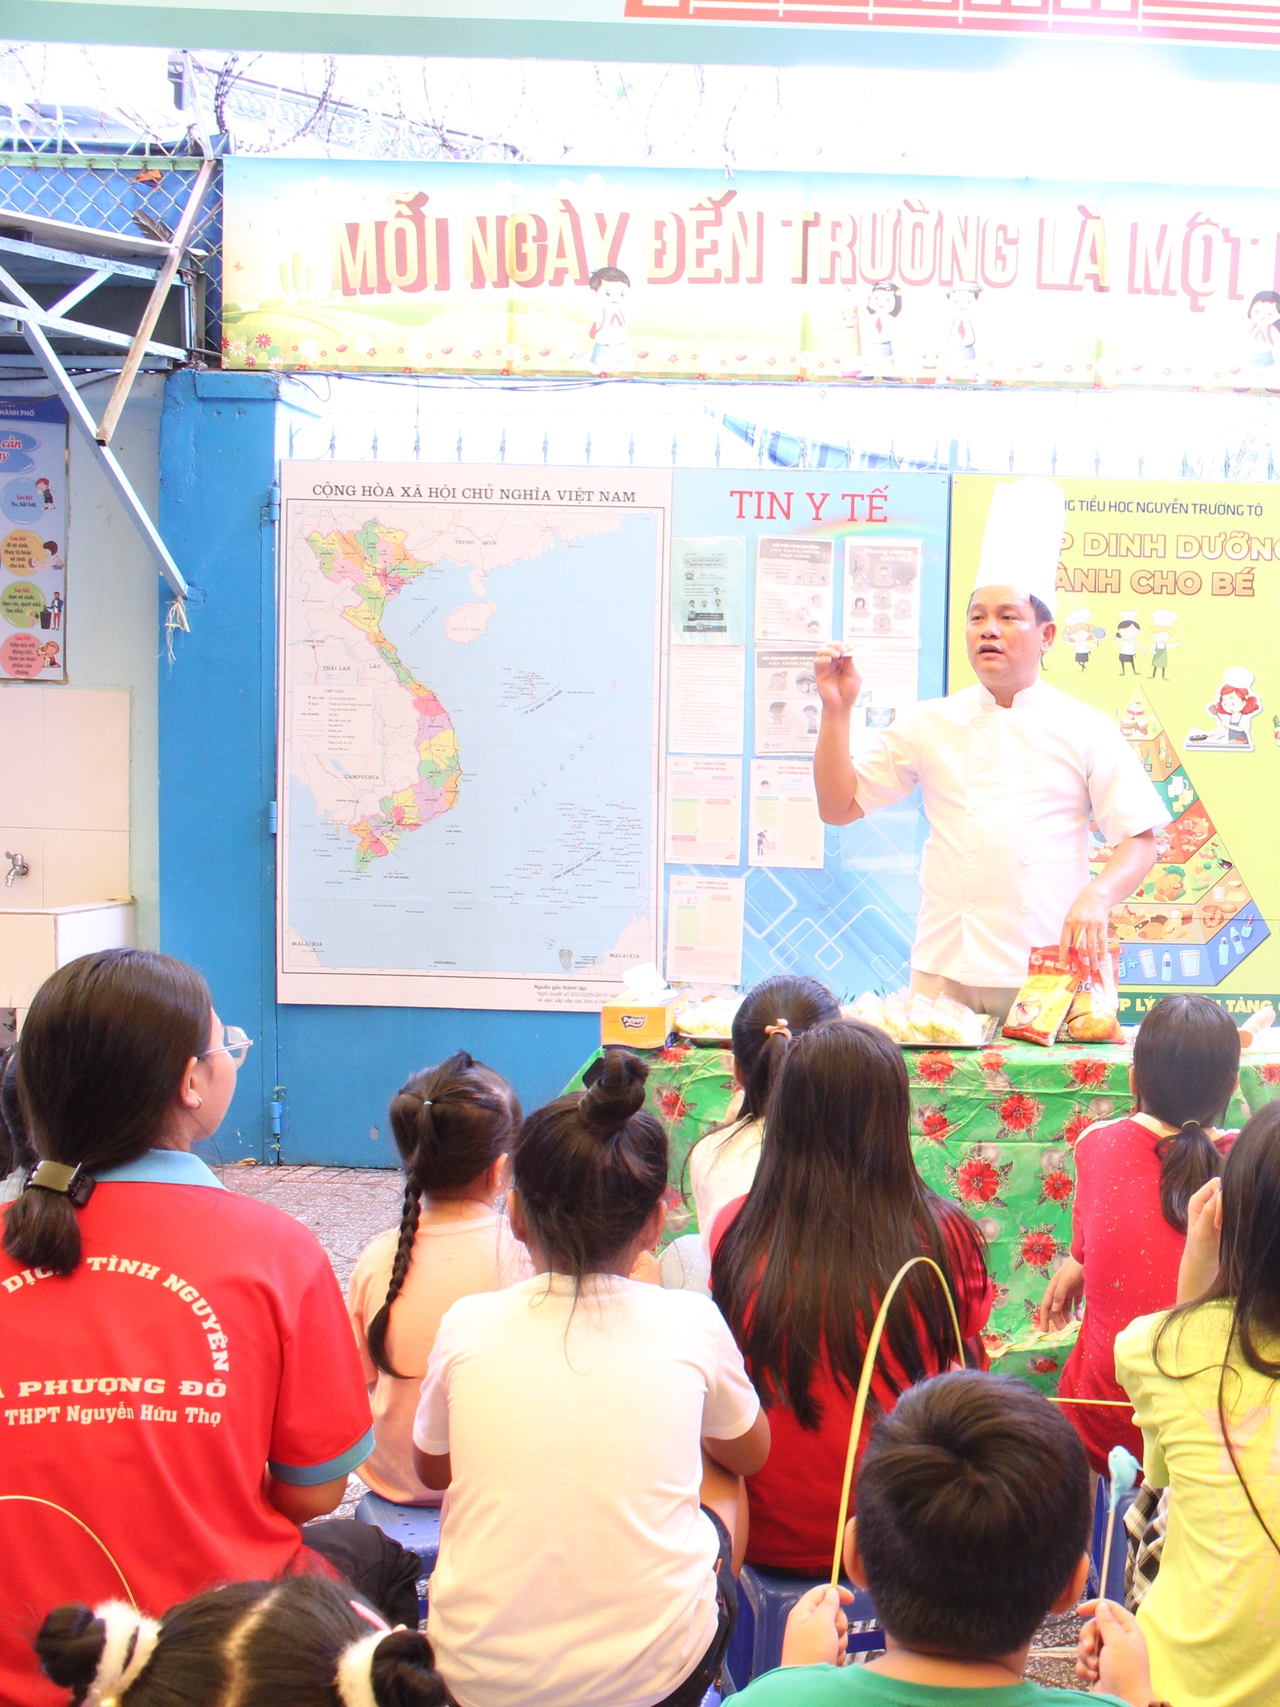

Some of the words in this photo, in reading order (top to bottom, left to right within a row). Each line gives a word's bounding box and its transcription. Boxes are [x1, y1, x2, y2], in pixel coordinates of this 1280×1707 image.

[329, 191, 451, 296] MỖI
[461, 198, 631, 289] NGÀY
[640, 189, 764, 284] ĐẾN
[781, 198, 1020, 289] TRƯỜNG
[1036, 204, 1110, 292] LÀ
[1128, 211, 1260, 312] MỘT
[2, 435, 21, 449] cần
[312, 482, 357, 499] CỘNG
[360, 483, 394, 498] HÒA
[400, 484, 422, 498] XÃ
[427, 484, 457, 500] HỘI
[461, 482, 494, 500] CHỦ
[499, 484, 551, 501] NGHĨA
[556, 485, 595, 504] VIỆT
[598, 490, 637, 503] NAM
[730, 490, 794, 520] TIN
[805, 492, 830, 521] Y
[841, 484, 891, 523] TẾ
[1078, 495, 1106, 512] TIỂU
[1109, 500, 1134, 515] HỌC
[1136, 497, 1189, 515] NGUYỄN
[1191, 500, 1245, 517] TRƯỜNG
[1247, 501, 1263, 518] TỘ
[482, 537, 499, 547] QUỐC
[1083, 532, 1167, 558] DINH
[1055, 562, 1121, 594] ÀNH
[1130, 569, 1203, 595] CHO
[1211, 567, 1256, 597] BÉ
[322, 664, 337, 672] THÁI
[369, 662, 382, 671] LÀO
[1135, 995, 1156, 1011] LÝ
[1, 1266, 58, 1294] DỊC
[86, 1253, 162, 1281] TÌNH
[18, 1376, 166, 1398] PHƯỢNG
[178, 1378, 228, 1398] ĐỎ
[5, 1406, 61, 1426] THPT
[66, 1400, 135, 1426] Nguyễn
[140, 1404, 178, 1424] Hữu
[185, 1406, 222, 1427] Thọ
